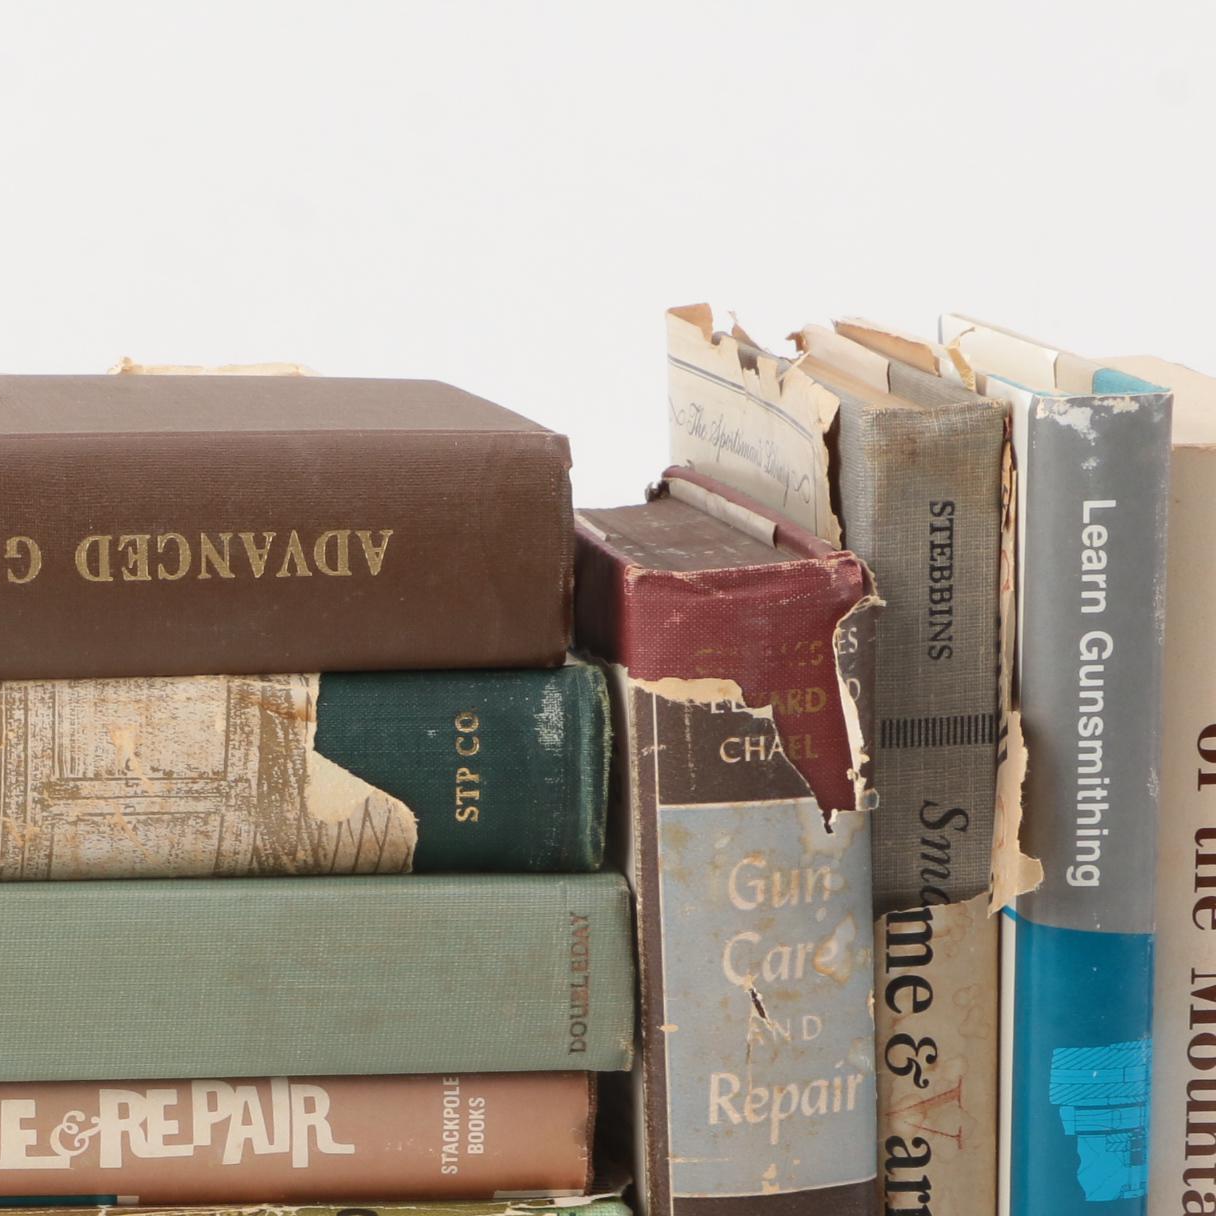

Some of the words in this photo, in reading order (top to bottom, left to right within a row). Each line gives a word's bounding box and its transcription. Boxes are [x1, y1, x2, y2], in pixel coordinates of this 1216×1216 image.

[75, 529, 394, 583] ADVANCED
[928, 500, 956, 662] STEBBINS
[1081, 500, 1117, 614] Learn
[456, 764, 480, 823] STP
[1066, 630, 1115, 888] Gunsmithing
[728, 853, 832, 911] Gun
[919, 800, 970, 906] Sma
[721, 931, 840, 987] Care
[885, 907, 934, 1015] me
[745, 1015, 823, 1046] AND
[884, 1032, 939, 1090] &
[49, 1111, 104, 1156] &
[99, 1077, 356, 1168] REPAIR
[441, 1077, 460, 1174] STACKPOLE
[467, 1097, 485, 1154] BOOKS
[708, 1068, 864, 1145] Repair
